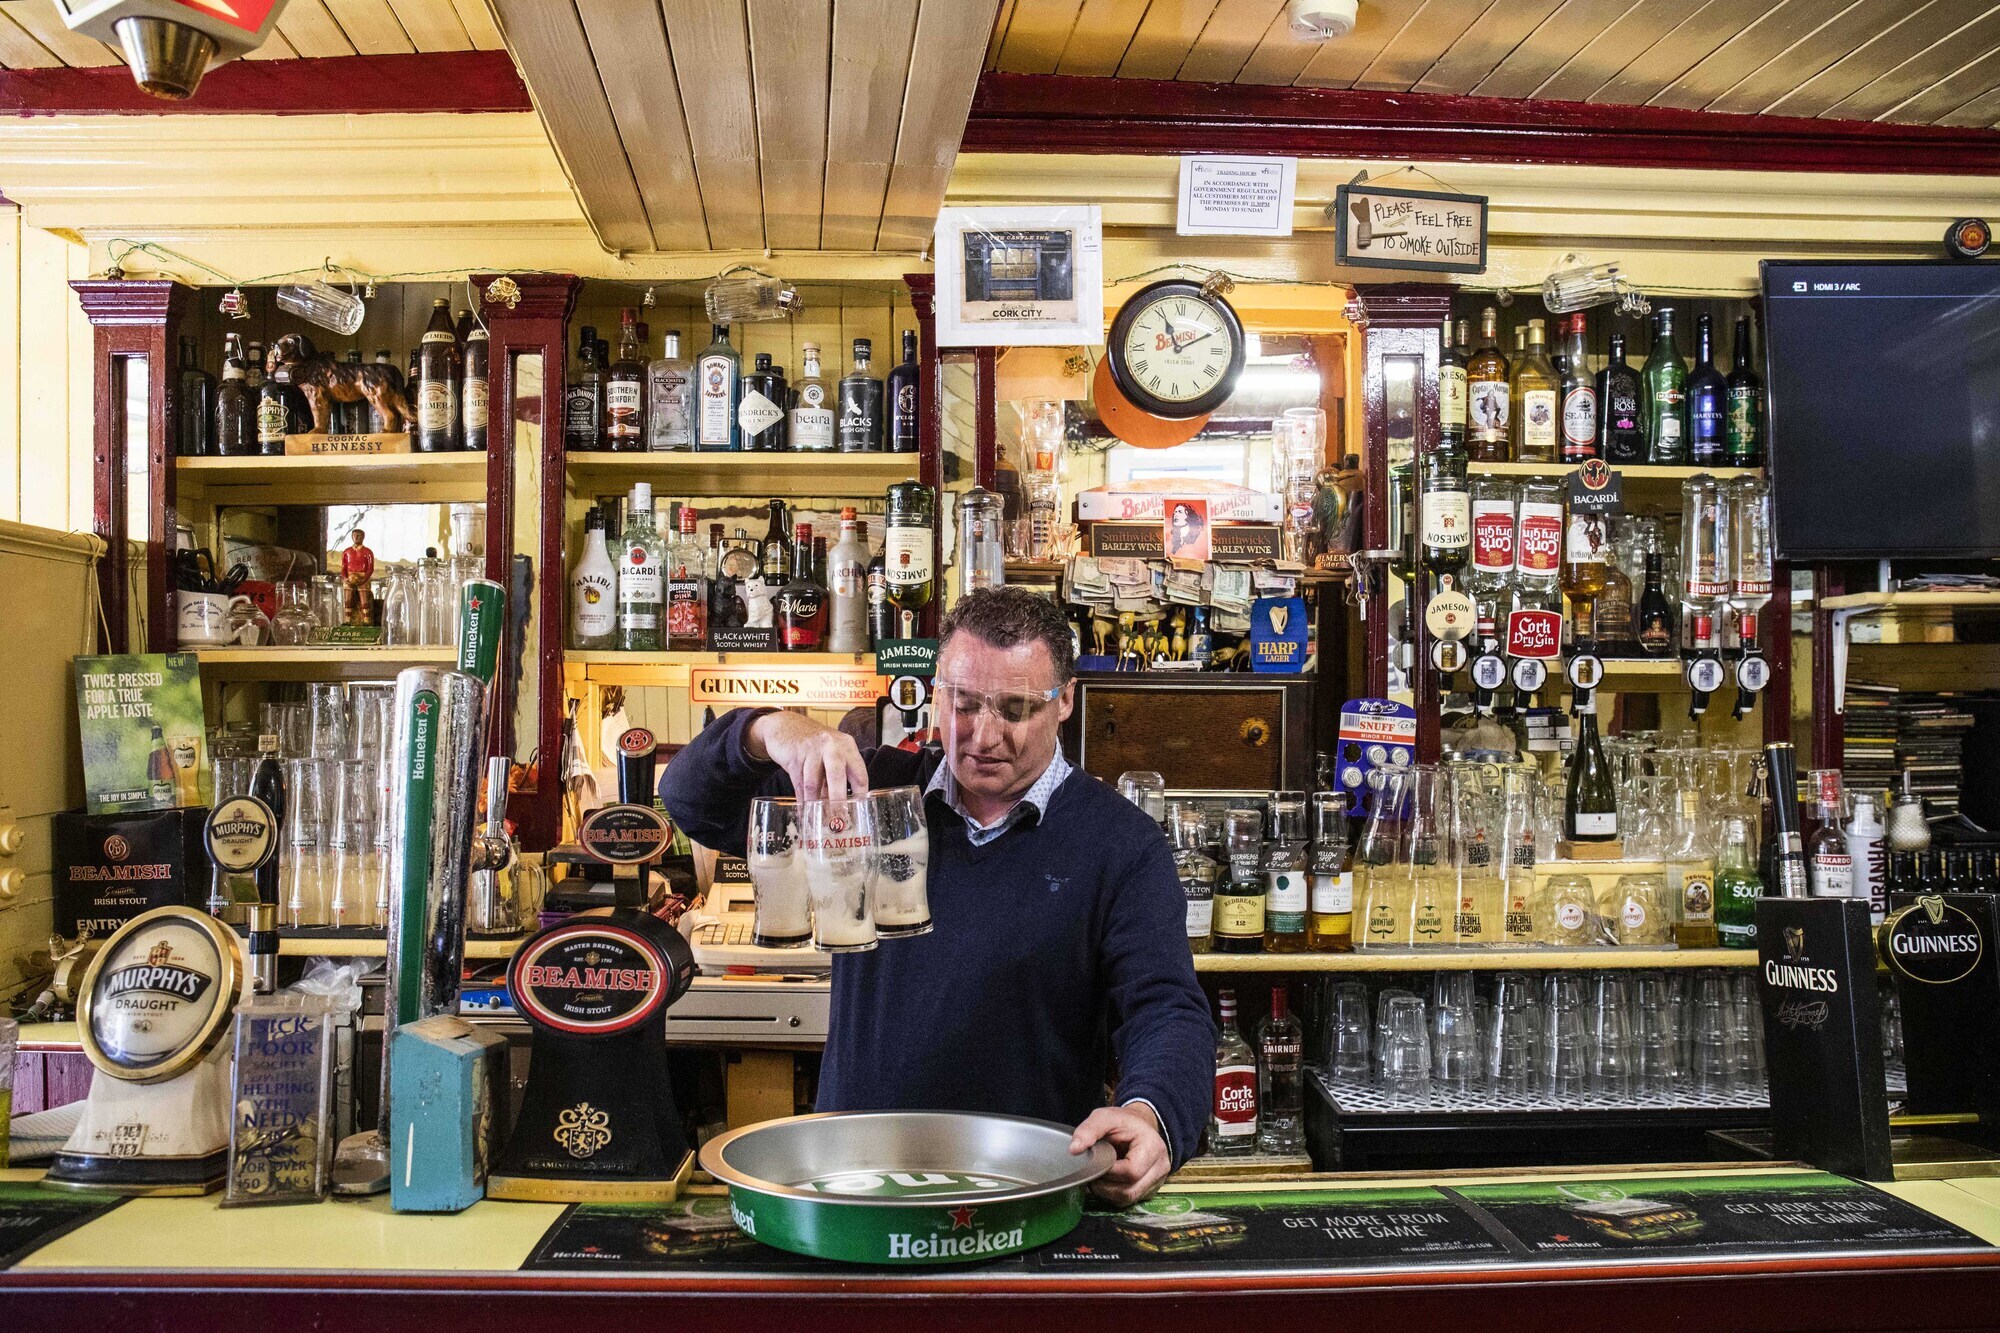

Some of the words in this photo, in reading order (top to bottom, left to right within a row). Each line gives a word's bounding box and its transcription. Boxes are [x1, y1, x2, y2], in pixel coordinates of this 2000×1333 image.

[1374, 201, 1414, 222] PLEASE
[1415, 211, 1444, 227] FEEL
[1446, 211, 1473, 227] FREE
[1399, 234, 1433, 256] SMOKE
[1436, 237, 1479, 257] OUTSIDE
[1814, 283, 1834, 291] HDMI
[1834, 283, 1839, 291] 3
[1845, 283, 1861, 291] ARC
[992, 310, 1019, 318] CORK
[1021, 309, 1043, 318] CITY
[608, 386, 638, 396] SOUTHERN
[608, 395, 636, 403] COMFORT
[1614, 402, 1636, 411] ROSE
[795, 413, 831, 425] beara
[839, 418, 872, 427] BLACKS
[312, 442, 383, 451] HENNESSY
[1574, 491, 1617, 504] BACARDÍ
[1232, 509, 1254, 517] STOUT
[1427, 532, 1469, 543] JAMESON
[1476, 526, 1495, 538] Gin
[1495, 526, 1513, 538] Dry
[1522, 528, 1541, 541] Gin
[1541, 529, 1560, 542] Dry
[1212, 535, 1271, 545] Smithwick's
[1480, 537, 1512, 552] Cork
[1101, 542, 1136, 551] BARLEY
[1137, 542, 1163, 551] WINE
[1212, 546, 1246, 554] BARLEY
[1247, 546, 1272, 554] WINE
[1525, 540, 1557, 555] Cork
[622, 565, 656, 576] BACARDÍ
[576, 575, 613, 591] MALIBU
[669, 583, 698, 592] BEEFEATER
[789, 599, 818, 616] Maria
[1431, 603, 1470, 614] JAMESON
[1518, 617, 1551, 634] Cork
[464, 611, 479, 669] Heineken
[1512, 633, 1534, 648] Dry
[1535, 633, 1555, 648] Gin
[879, 645, 935, 661] JAMESON
[1258, 641, 1298, 655] HARP
[167, 656, 187, 668] NEW!
[1265, 654, 1290, 662] LAGER
[83, 673, 117, 688] TWICE
[119, 672, 163, 688] PRESSED
[819, 677, 839, 688] No
[840, 676, 869, 688] beer
[700, 678, 800, 695] GUINNESS
[85, 689, 105, 703] FOR
[107, 689, 116, 703] A
[117, 688, 144, 703] TRUE
[806, 688, 848, 699] comes
[87, 704, 120, 720] APPLE
[122, 703, 154, 718] TASTE
[1359, 721, 1396, 732] SNUFF
[412, 717, 427, 781] Heineken
[99, 794, 110, 803] THE
[120, 793, 127, 801] IN
[126, 791, 147, 801] SIMPLE
[215, 822, 261, 836] MURPHY'S
[221, 837, 253, 845] DRAUGHT
[585, 828, 664, 843] BEAMISH
[807, 835, 872, 850] BEAMISH
[1469, 846, 1490, 857] THIEVES
[1816, 856, 1851, 865] LUXARDO
[69, 864, 171, 881] BEAMISH
[722, 863, 747, 872] BLACK
[1868, 837, 1886, 915] PIRANHA
[118, 897, 147, 905] STOUT
[1223, 898, 1259, 908] REDBREAST
[1332, 898, 1341, 906] 12
[76, 918, 128, 932] ENTRY
[1454, 915, 1482, 925] THIEVES
[1505, 915, 1533, 925] THIEVES
[1453, 924, 1482, 933] ORCHARD
[1505, 923, 1533, 932] ORCHARD
[564, 942, 591, 953] MASTER
[592, 942, 624, 955] BREWERS
[1892, 933, 1976, 954] GUINNESS
[111, 966, 200, 996] MURPHY'S
[526, 965, 657, 991] BEAMISH
[1765, 959, 1838, 993] GUINNESS
[115, 1000, 179, 1011] DRAUGHT
[563, 1003, 585, 1014] IRISH
[586, 1005, 612, 1014] STOUT
[248, 1040, 314, 1057] POOR
[1263, 1045, 1301, 1054] SMIRNOFF
[243, 1082, 315, 1096] HELPING
[1221, 1085, 1254, 1101] Cork
[1219, 1101, 1239, 1112] Dry
[1239, 1100, 1255, 1111] Gin
[244, 1112, 309, 1128] NEEDY
[1725, 1203, 1763, 1214] GET
[1767, 1201, 1824, 1214] MORE
[1829, 1200, 1888, 1212] FROM
[1282, 1217, 1323, 1229] GET
[1325, 1214, 1385, 1228] MORE
[1387, 1212, 1449, 1225] FROM
[1776, 1213, 1819, 1226] THE
[1822, 1211, 1879, 1225] GAME
[1322, 1226, 1364, 1241] THE
[1366, 1224, 1428, 1239] GAME
[887, 1226, 1024, 1259] Heineken
[1537, 1241, 1602, 1249] Heineken
[553, 1251, 621, 1260] Heineken
[1053, 1252, 1120, 1260] Heineken
